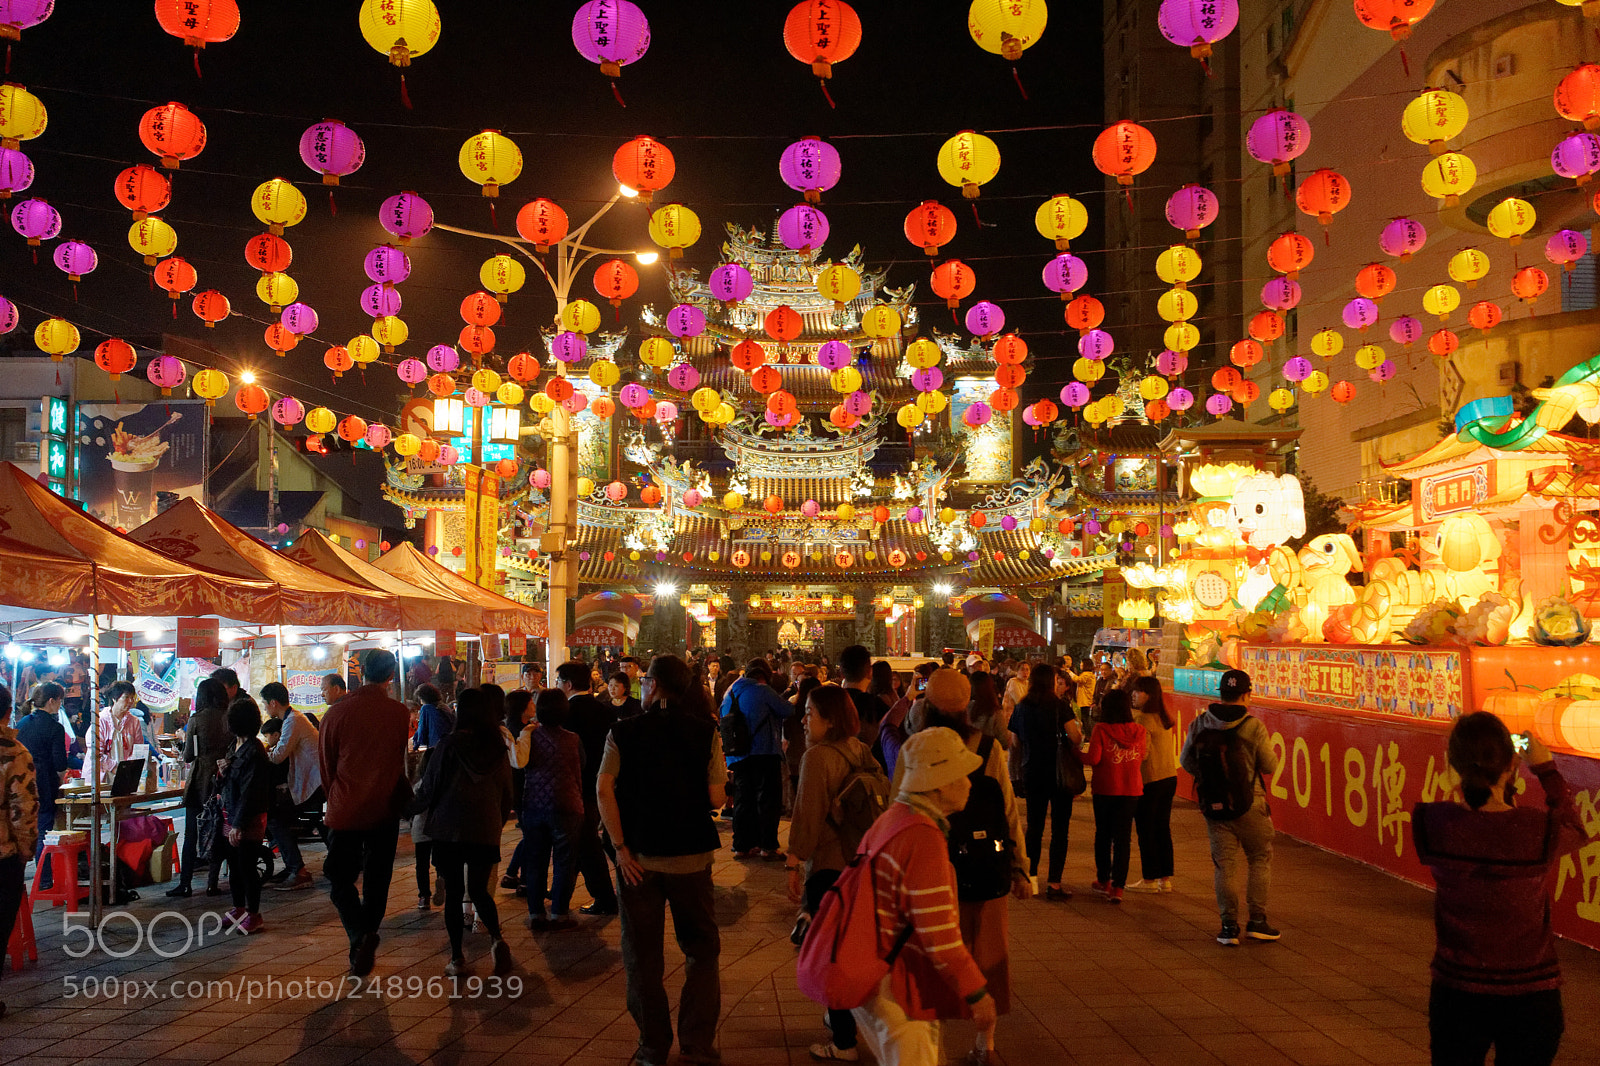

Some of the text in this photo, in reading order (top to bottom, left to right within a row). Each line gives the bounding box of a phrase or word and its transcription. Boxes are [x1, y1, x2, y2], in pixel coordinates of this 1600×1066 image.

[1434, 92, 1448, 127] 天上聖母
[314, 131, 328, 164] 慈祐宮
[643, 147, 656, 180] 慈祐宮
[801, 147, 814, 180] 慈祐宮
[957, 135, 971, 170] 天上聖母
[785, 554, 796, 565] 新
